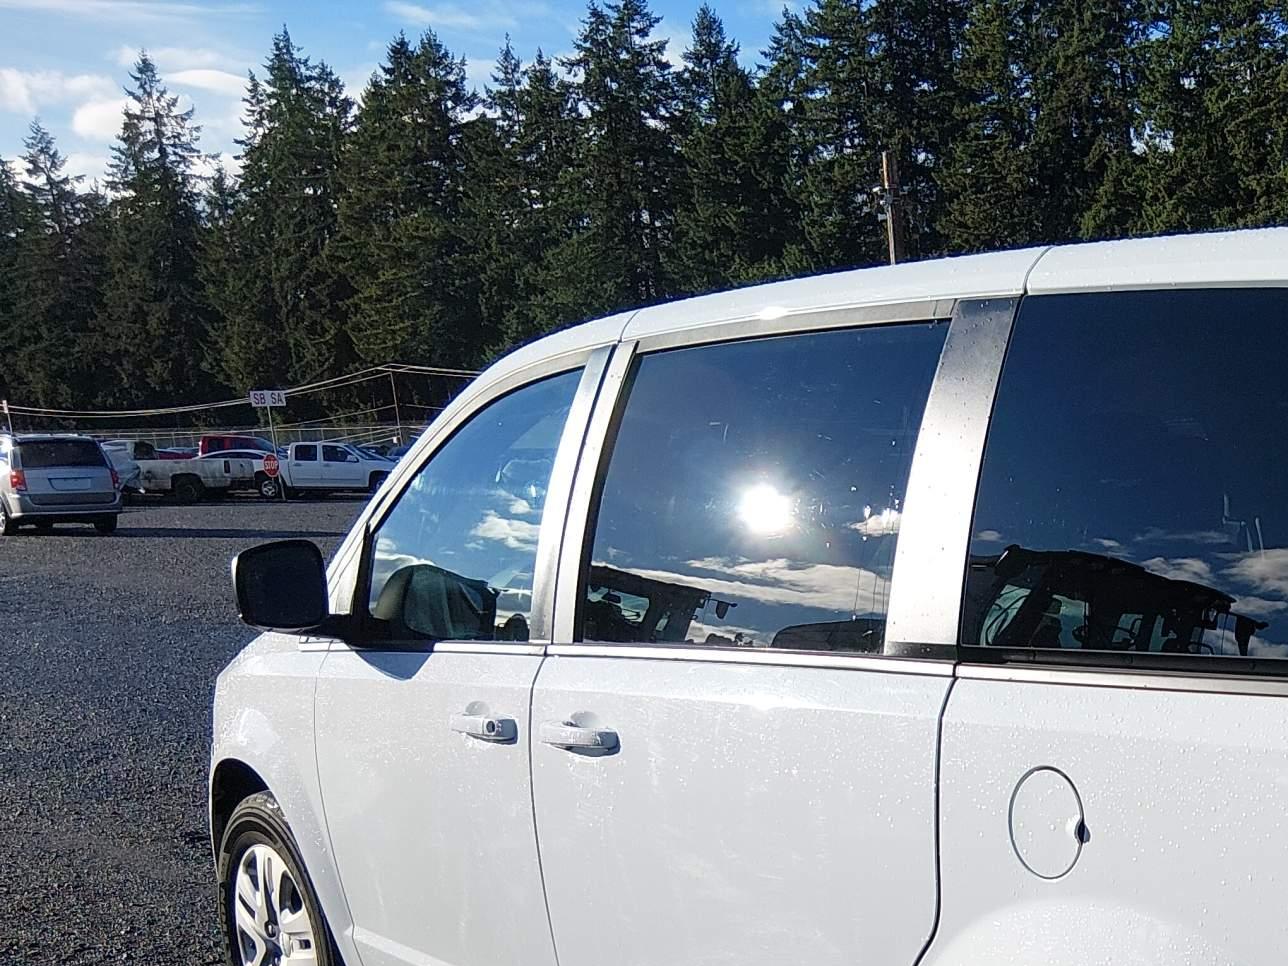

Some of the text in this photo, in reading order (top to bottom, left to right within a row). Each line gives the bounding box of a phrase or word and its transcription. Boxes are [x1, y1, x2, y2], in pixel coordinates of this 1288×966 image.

[253, 392, 284, 405] SB SA
[264, 461, 278, 470] STOP
